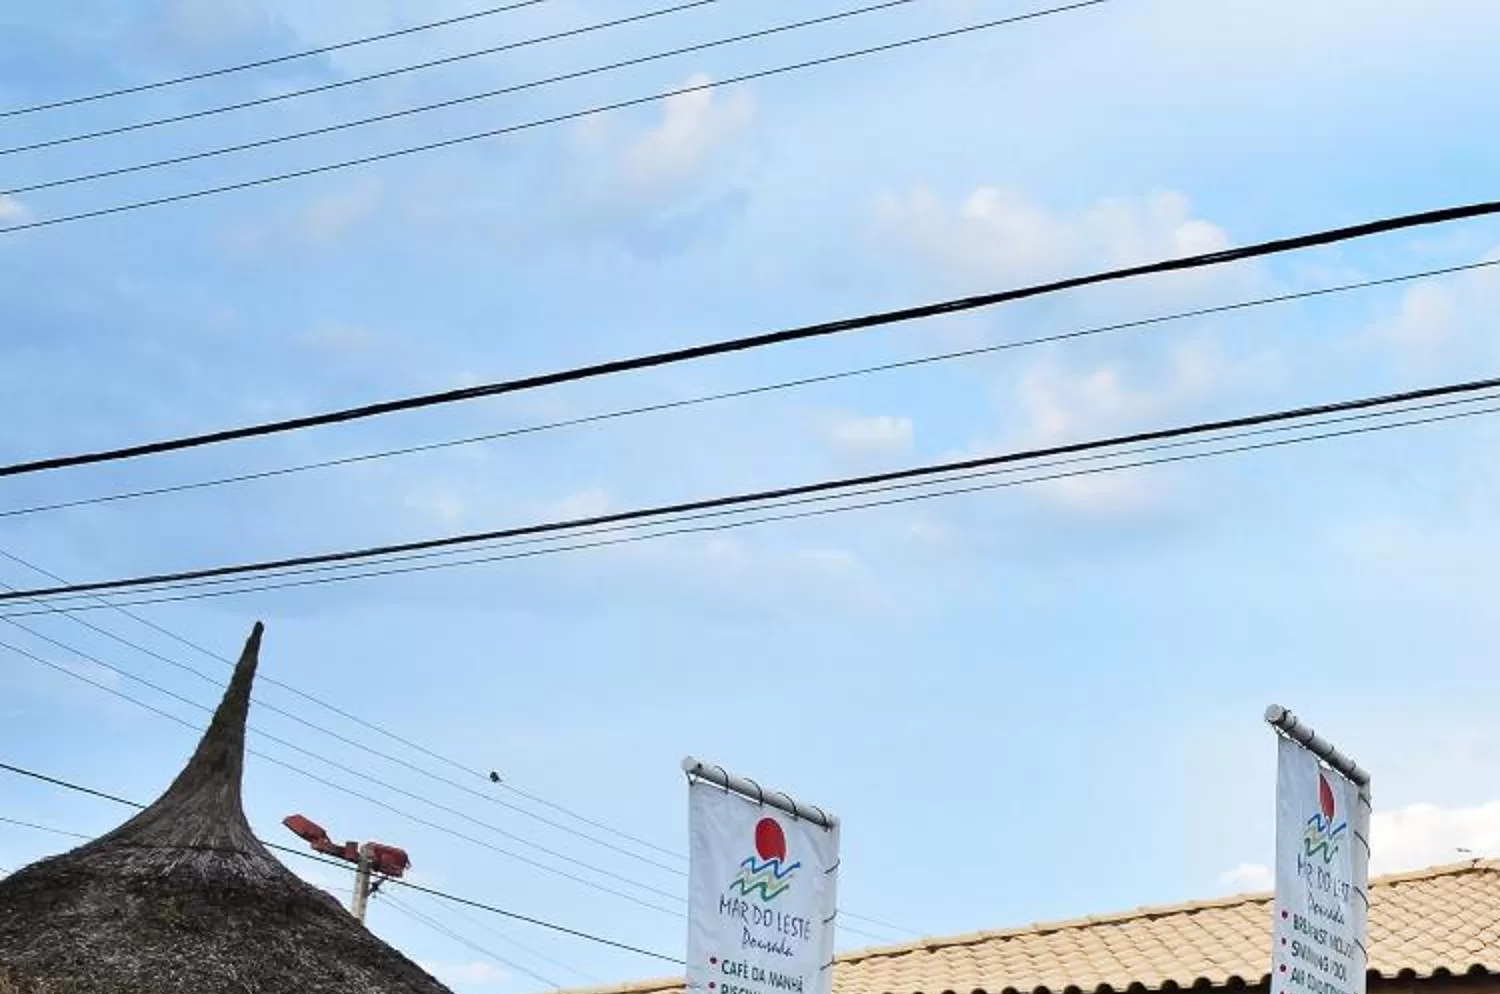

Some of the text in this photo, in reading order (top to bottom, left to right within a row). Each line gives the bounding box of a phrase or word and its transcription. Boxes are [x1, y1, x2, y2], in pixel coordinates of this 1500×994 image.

[719, 894, 811, 941] MAR DO LESTE
[751, 967, 766, 984] DA
[768, 971, 804, 993] MANHÃ
